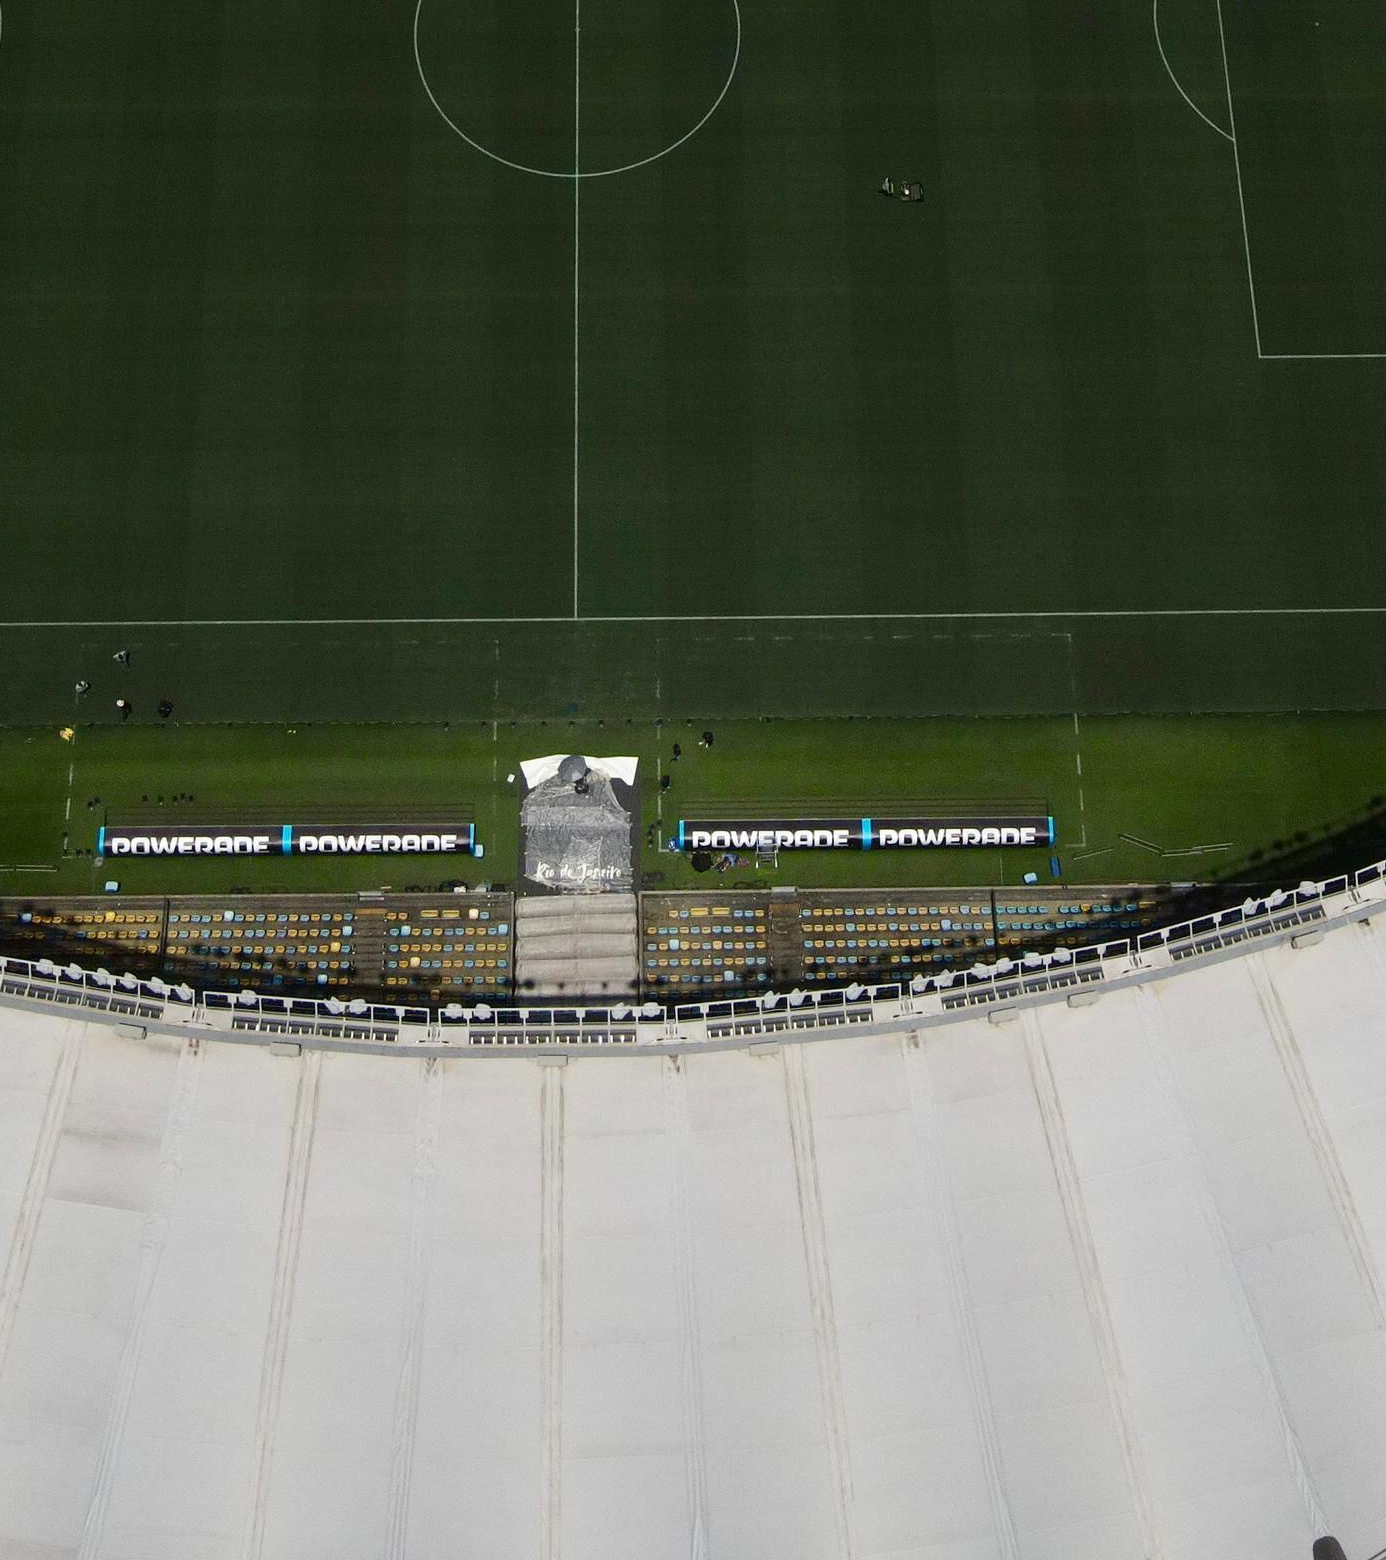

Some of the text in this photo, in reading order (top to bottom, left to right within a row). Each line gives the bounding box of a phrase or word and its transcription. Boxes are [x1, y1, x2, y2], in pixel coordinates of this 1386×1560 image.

[111, 836, 270, 854] POWERADE
[299, 834, 457, 852] POWERADE
[692, 829, 850, 848] POWERADE
[879, 827, 1036, 846] POWERADE
[536, 861, 622, 883] Rio de Janeiro
